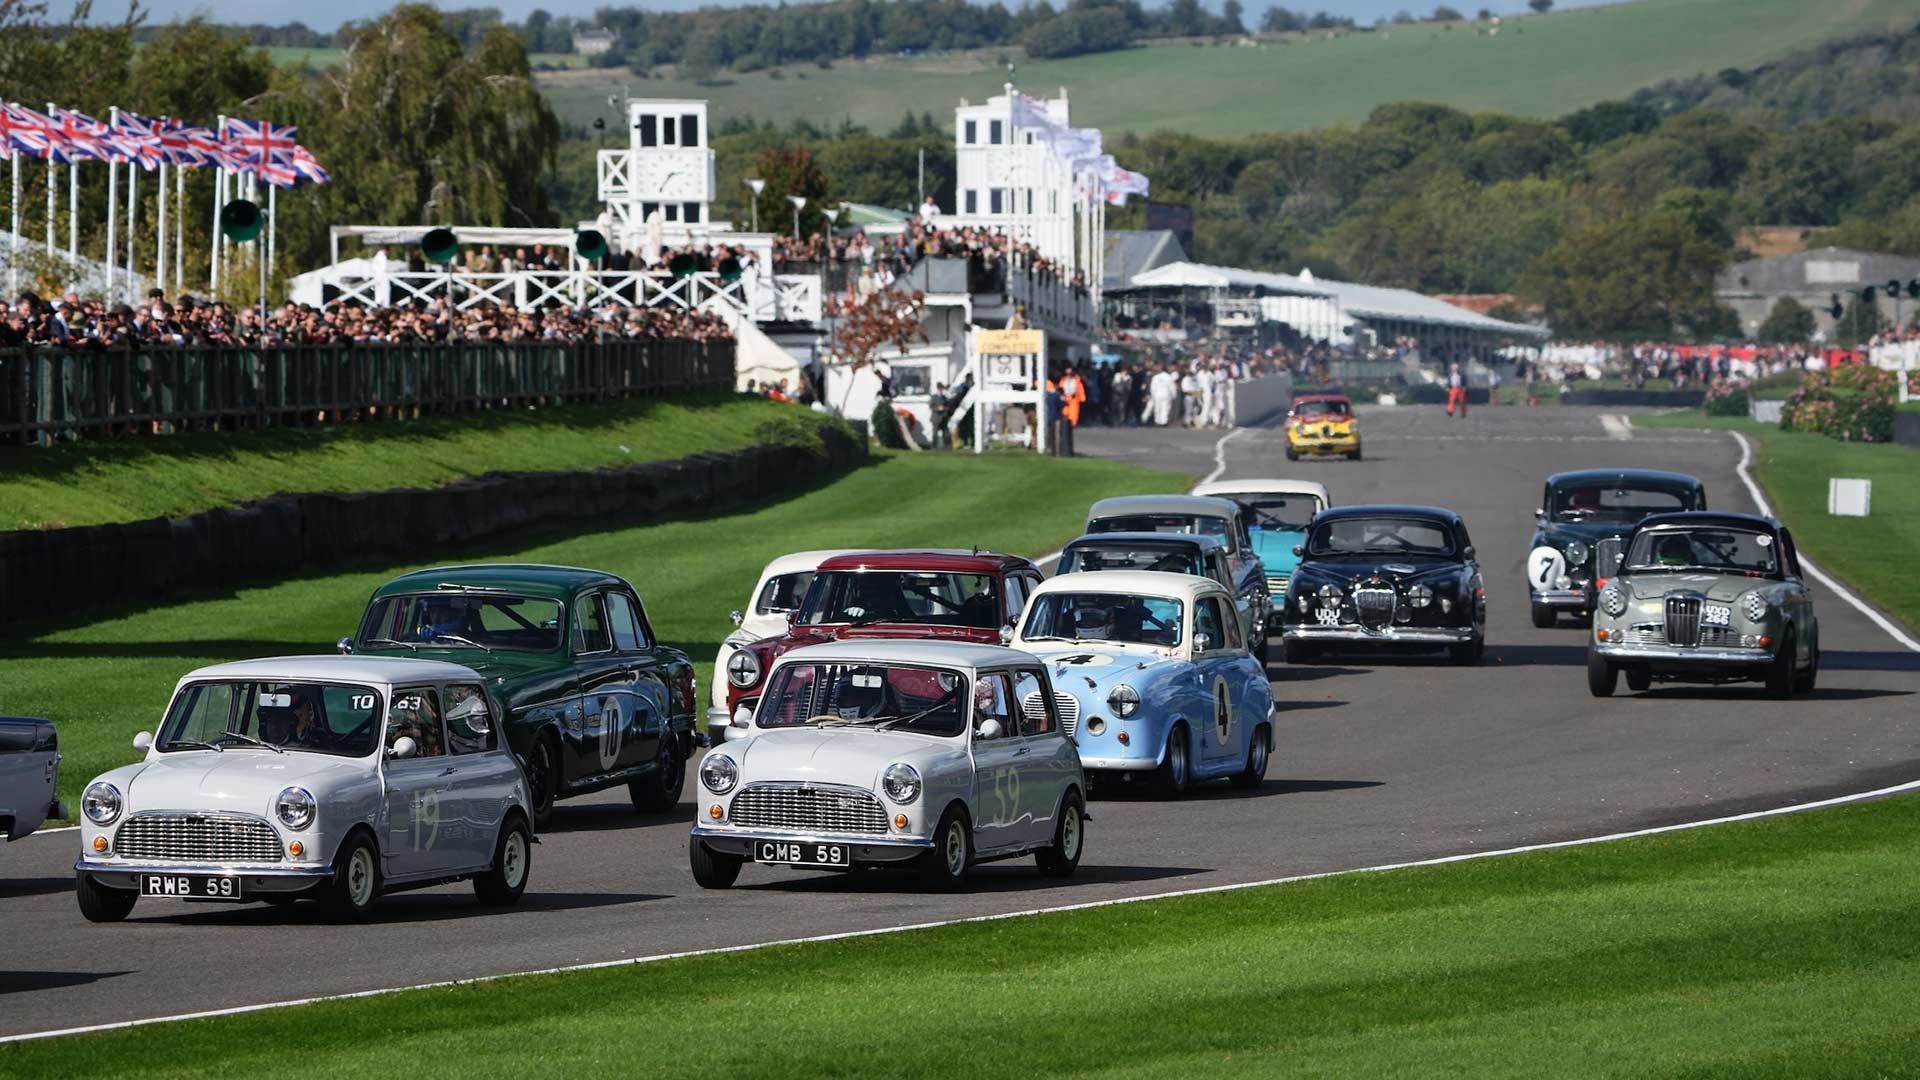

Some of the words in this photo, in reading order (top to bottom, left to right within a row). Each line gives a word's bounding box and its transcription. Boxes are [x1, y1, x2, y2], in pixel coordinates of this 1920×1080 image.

[1540, 556, 1555, 584] 7
[1705, 605, 1731, 616] UXD
[1705, 613, 1730, 626] 266
[1055, 654, 1096, 665] 4
[1218, 682, 1228, 737] 4
[604, 708, 619, 757] 10
[993, 766, 1020, 824] 59
[413, 788, 440, 853] 19
[762, 843, 802, 862] CMB
[816, 845, 841, 864] 59
[148, 876, 191, 895] RWB
[206, 878, 232, 896] 59
